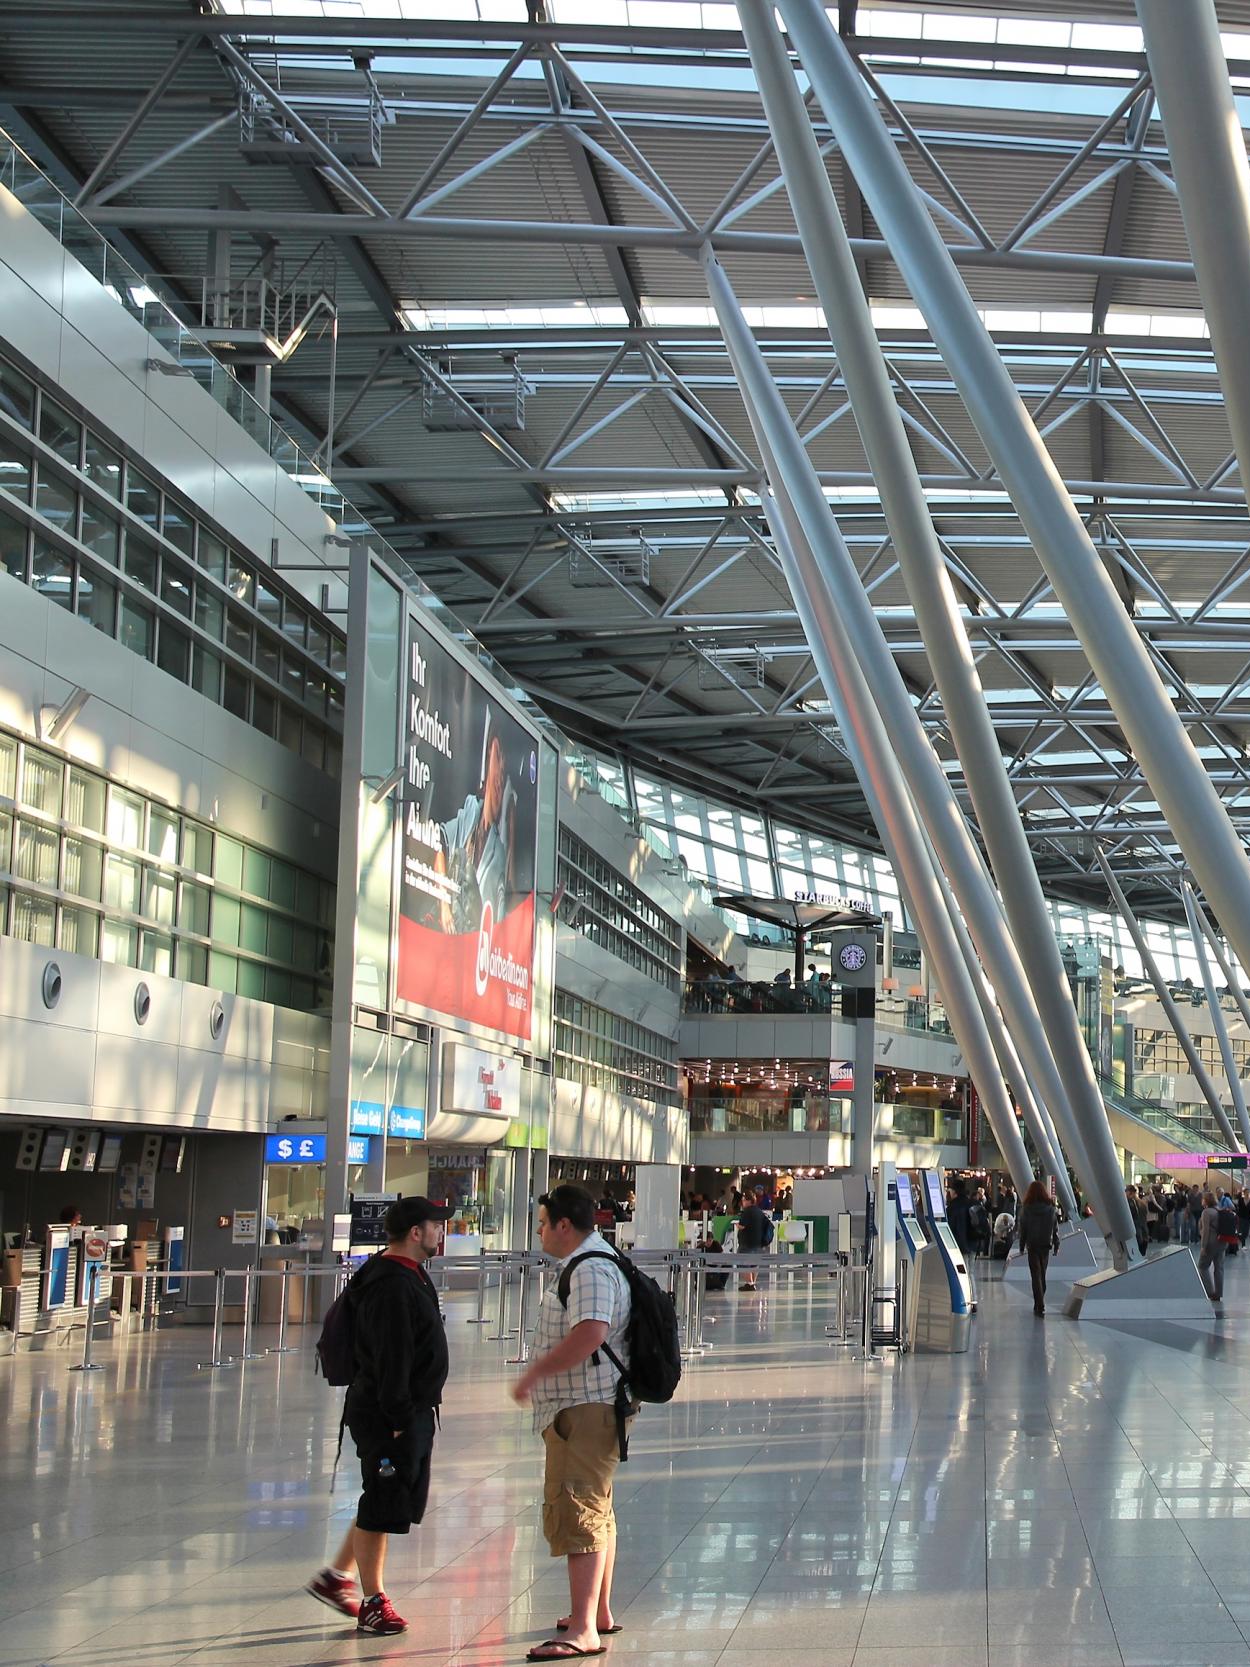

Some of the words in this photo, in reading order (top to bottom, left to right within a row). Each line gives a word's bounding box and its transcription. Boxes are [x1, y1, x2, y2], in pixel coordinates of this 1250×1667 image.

[411, 641, 427, 688] Ihr
[410, 694, 452, 760] Komfort.
[408, 745, 431, 790] Ihre
[795, 891, 850, 908] STARBUCKS
[489, 947, 528, 990] airberlin.com
[277, 1139, 293, 1159] $
[299, 1139, 314, 1157] £
